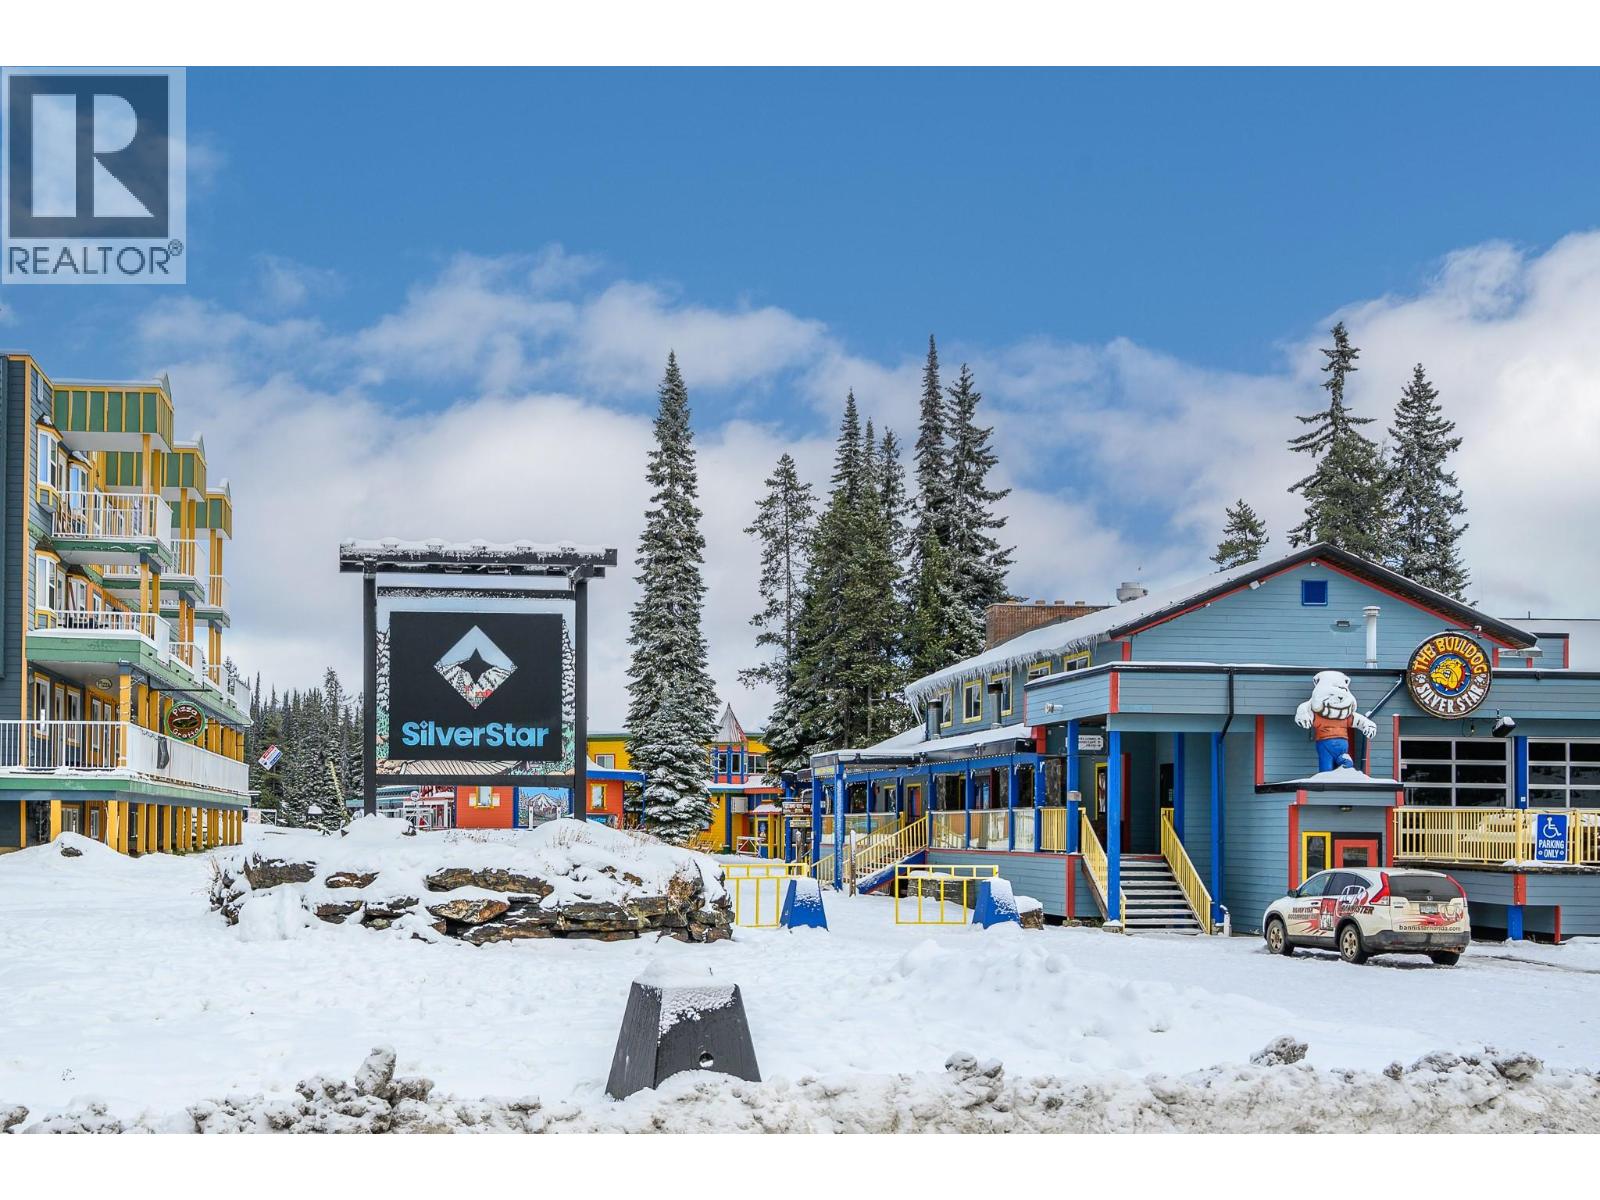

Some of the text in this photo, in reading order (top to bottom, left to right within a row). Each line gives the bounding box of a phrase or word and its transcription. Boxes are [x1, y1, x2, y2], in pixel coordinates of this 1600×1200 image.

[1413, 636, 1488, 674] THE BULLDOG
[1416, 683, 1485, 713] SILVER STAR
[172, 706, 198, 717] Pizza
[401, 720, 549, 747] SilverStar
[1538, 839, 1565, 850] PARKING
[1543, 849, 1560, 858] ONLY
[1341, 904, 1375, 915] BANNISTER
[1398, 924, 1462, 932] bannisterhonda.com
